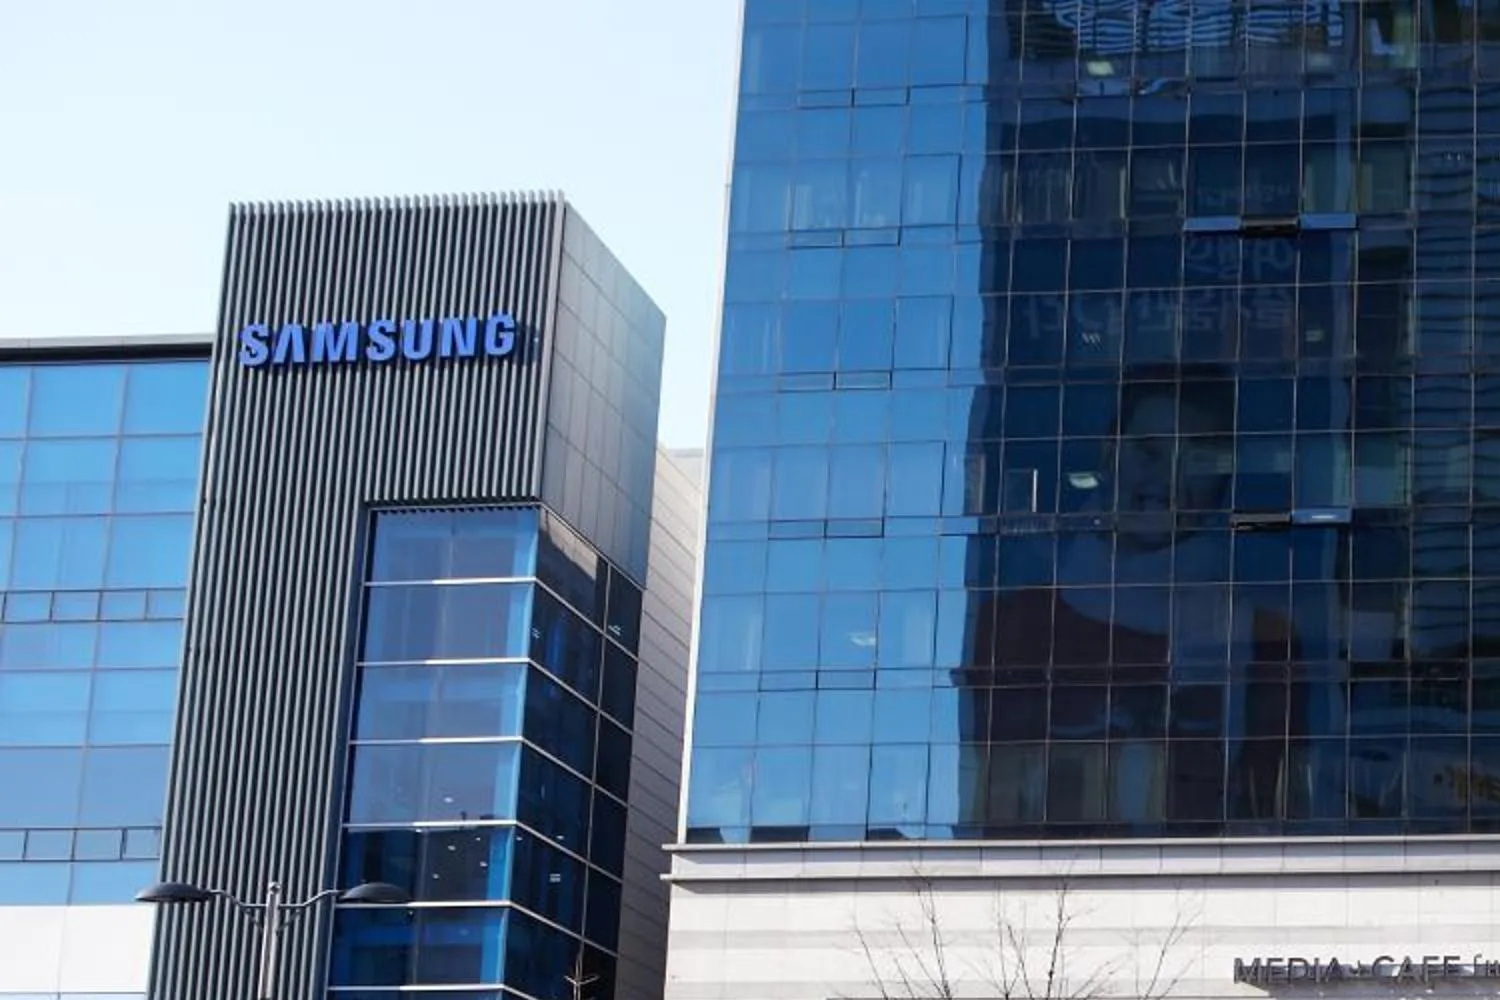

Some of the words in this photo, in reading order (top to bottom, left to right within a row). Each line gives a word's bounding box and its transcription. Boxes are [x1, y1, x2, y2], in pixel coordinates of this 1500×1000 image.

[239, 309, 516, 368] SAMSUNG
[1233, 956, 1345, 984] MEDIA
[1371, 955, 1462, 984] CAFE
